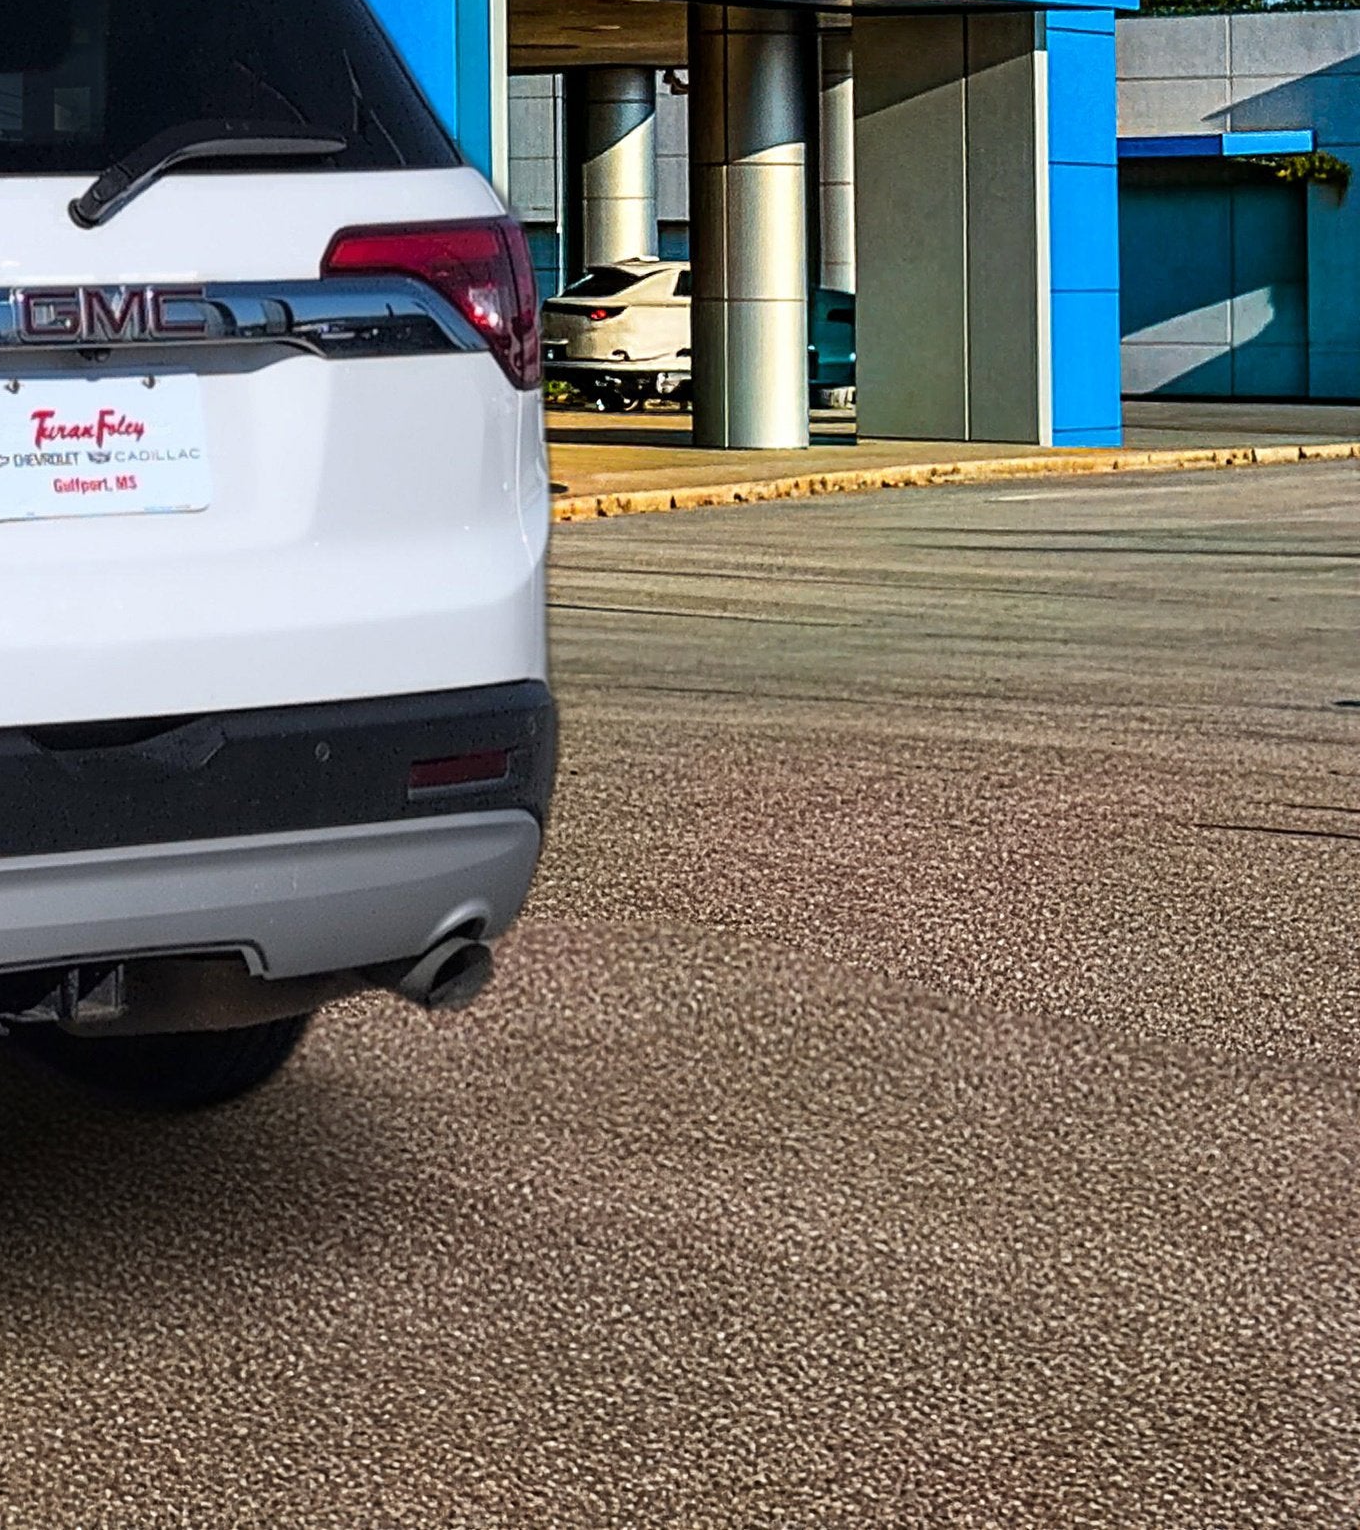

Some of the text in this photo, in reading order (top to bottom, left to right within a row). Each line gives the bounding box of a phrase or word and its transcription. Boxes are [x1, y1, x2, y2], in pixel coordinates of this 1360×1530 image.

[12, 285, 207, 344] GMC
[31, 410, 145, 449] Turan Foley
[13, 448, 201, 468] CHEVROLET CADILLAC
[116, 474, 138, 490] MS
